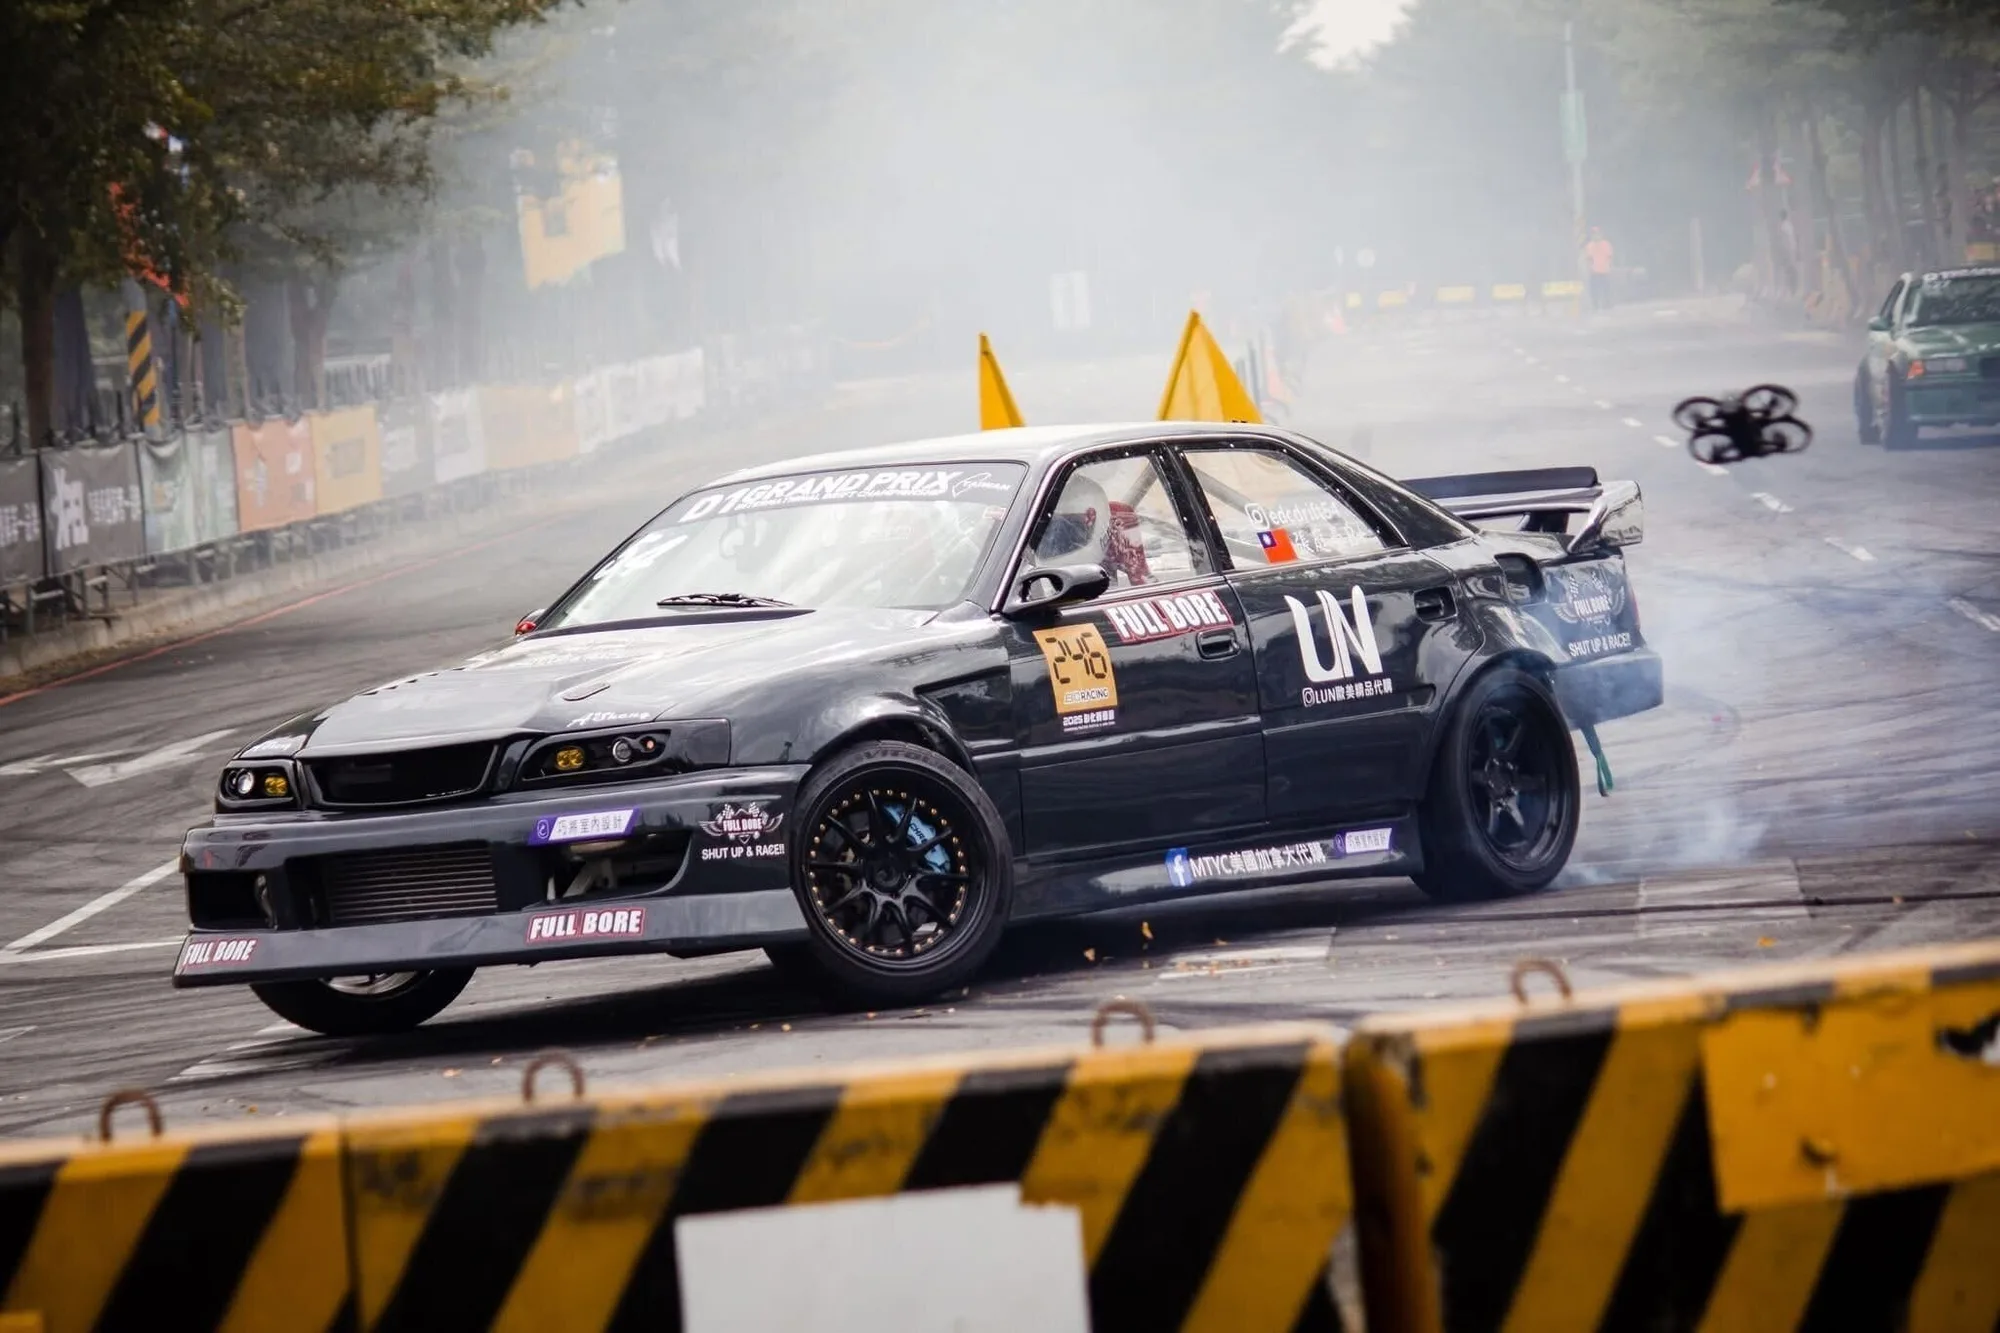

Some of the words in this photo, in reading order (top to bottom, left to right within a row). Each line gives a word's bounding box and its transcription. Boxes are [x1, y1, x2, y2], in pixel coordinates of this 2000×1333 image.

[866, 471, 964, 492] PRIX
[1105, 602, 1169, 640] FULL
[1163, 591, 1229, 630] BORE
[1045, 632, 1107, 684] 246
[1568, 640, 1590, 657] SHUT
[1590, 638, 1602, 653] UP
[722, 819, 741, 832] FULL
[702, 847, 728, 860] SHUT
[730, 846, 744, 858] UP
[746, 845, 754, 857] &
[529, 914, 577, 940] FULL
[582, 910, 642, 934] BORE
[183, 942, 215, 966] FULL
[213, 940, 257, 961] BORE
